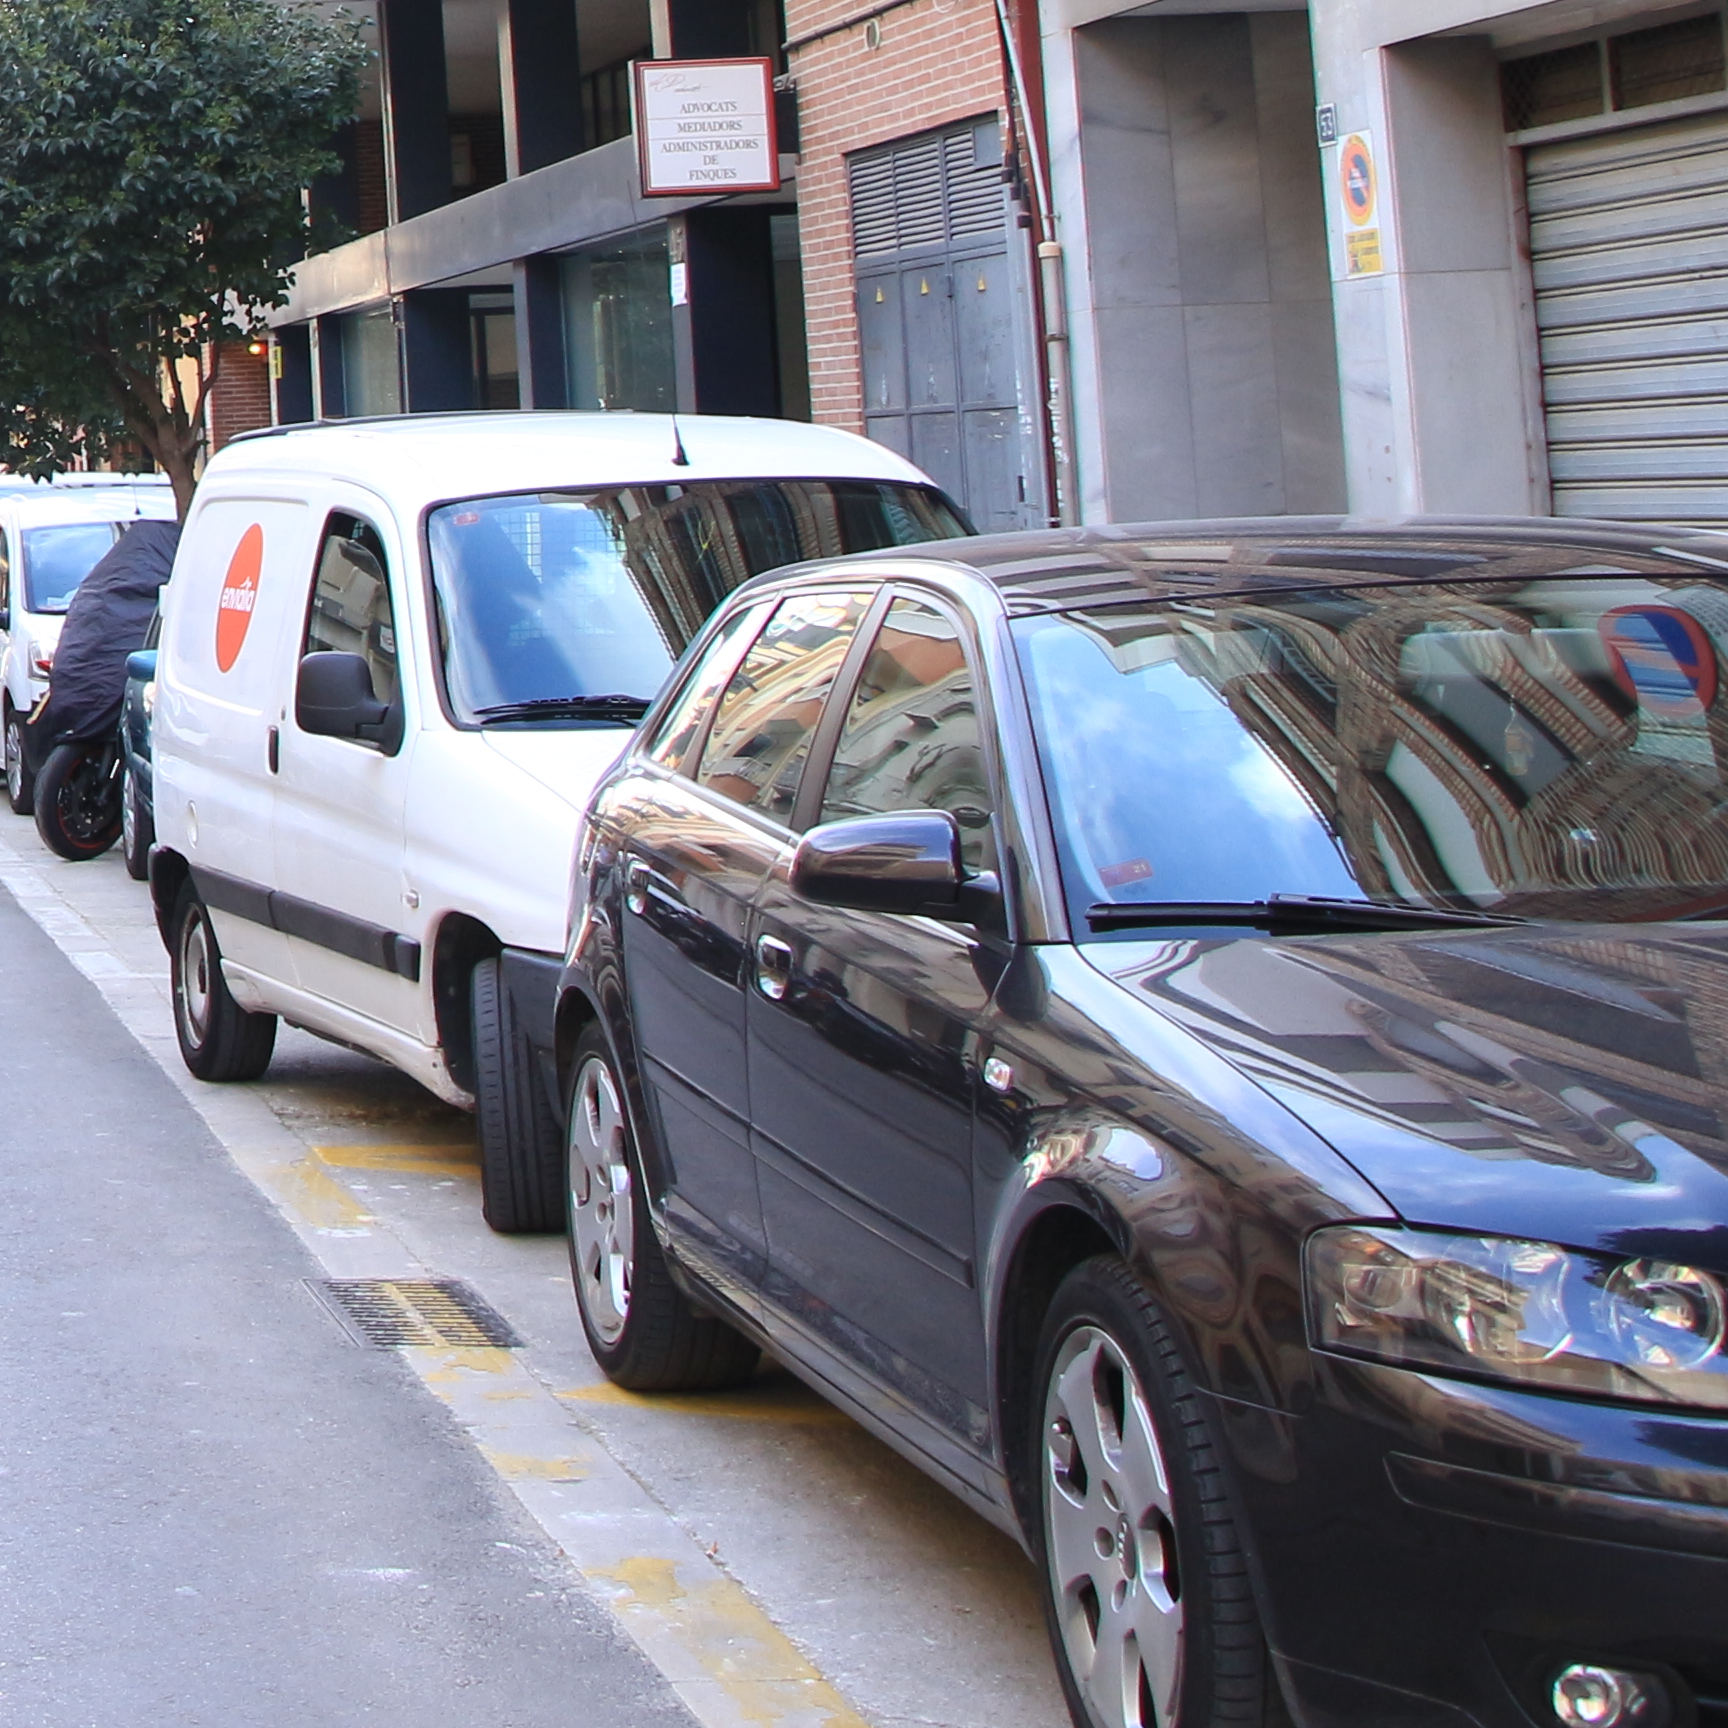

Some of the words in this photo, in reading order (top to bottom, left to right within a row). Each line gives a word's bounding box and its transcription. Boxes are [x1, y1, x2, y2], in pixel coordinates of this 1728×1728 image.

[680, 101, 737, 114] ADVOCATS
[677, 120, 743, 133] MEDIADORS
[661, 138, 759, 153] ADMINISTRADORS
[703, 155, 719, 166] DE
[689, 168, 737, 181] FINQUES
